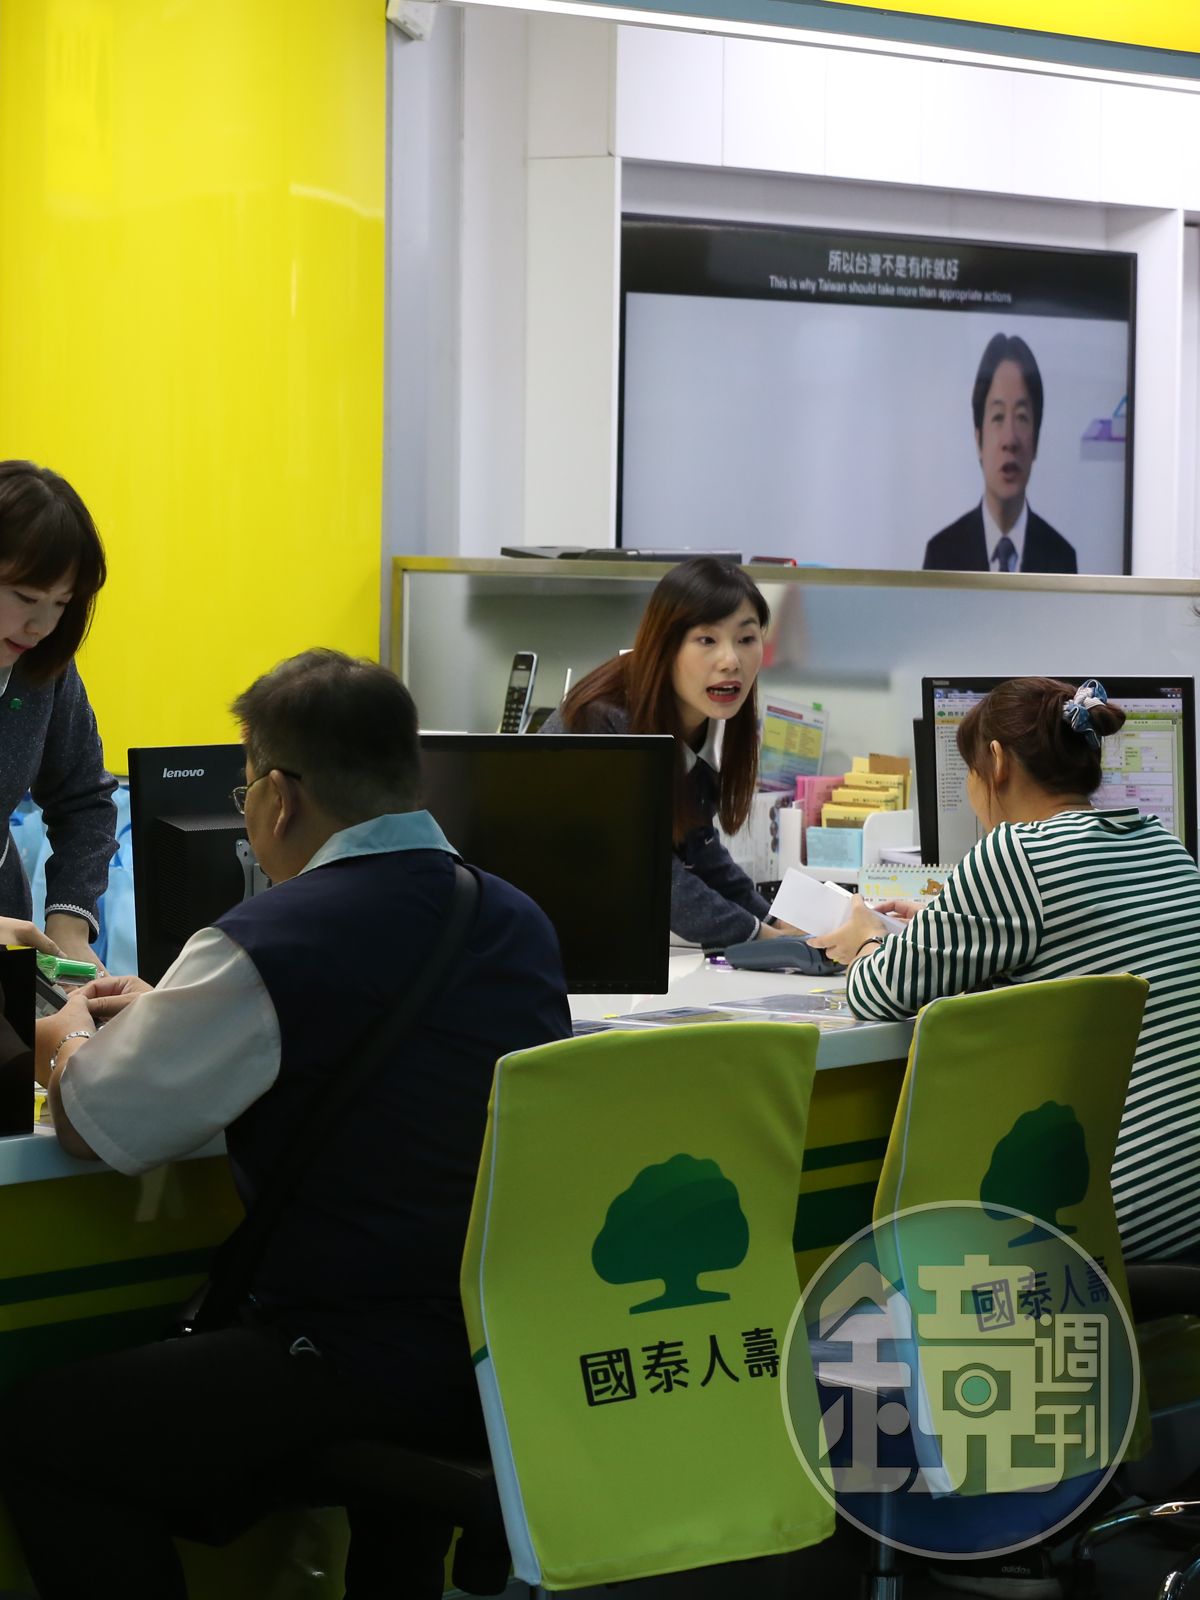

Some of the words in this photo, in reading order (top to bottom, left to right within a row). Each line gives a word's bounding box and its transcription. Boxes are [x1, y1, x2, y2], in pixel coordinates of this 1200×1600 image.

[769, 275, 788, 289] This
[790, 277, 797, 289] is
[800, 277, 816, 294] why
[818, 278, 847, 293] Taiwan
[849, 280, 876, 295] should
[878, 283, 895, 296] take
[896, 286, 917, 297] more
[918, 285, 937, 298] than
[938, 287, 982, 303] appropriate
[984, 290, 1012, 303] actions
[163, 768, 205, 778] lenovo
[972, 1256, 1110, 1332] 國泰人壽
[579, 1328, 780, 1407] 國泰人壽
